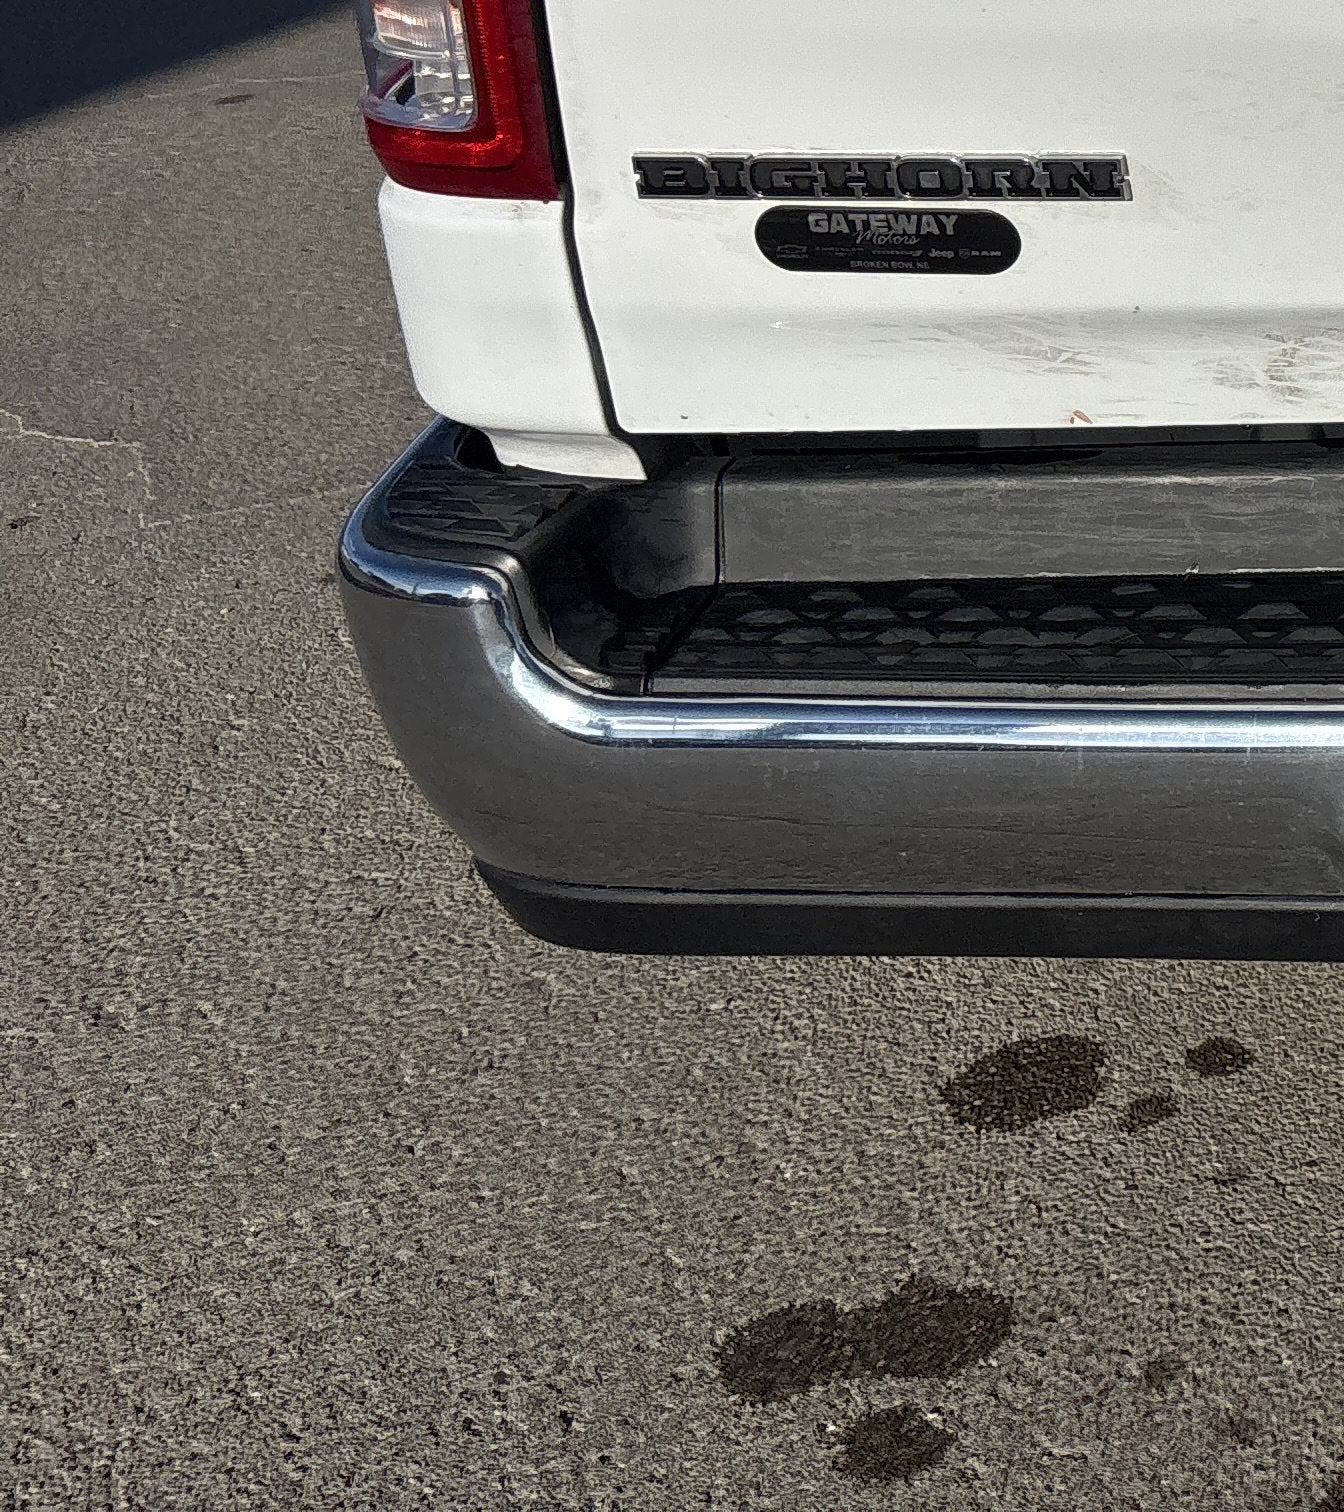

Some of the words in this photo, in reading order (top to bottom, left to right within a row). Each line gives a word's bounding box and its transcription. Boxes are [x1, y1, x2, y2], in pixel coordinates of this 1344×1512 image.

[633, 151, 1132, 201] BIGHORN
[808, 212, 958, 236] GATEWAY
[853, 228, 920, 245] Motors
[928, 248, 955, 259] Jeep
